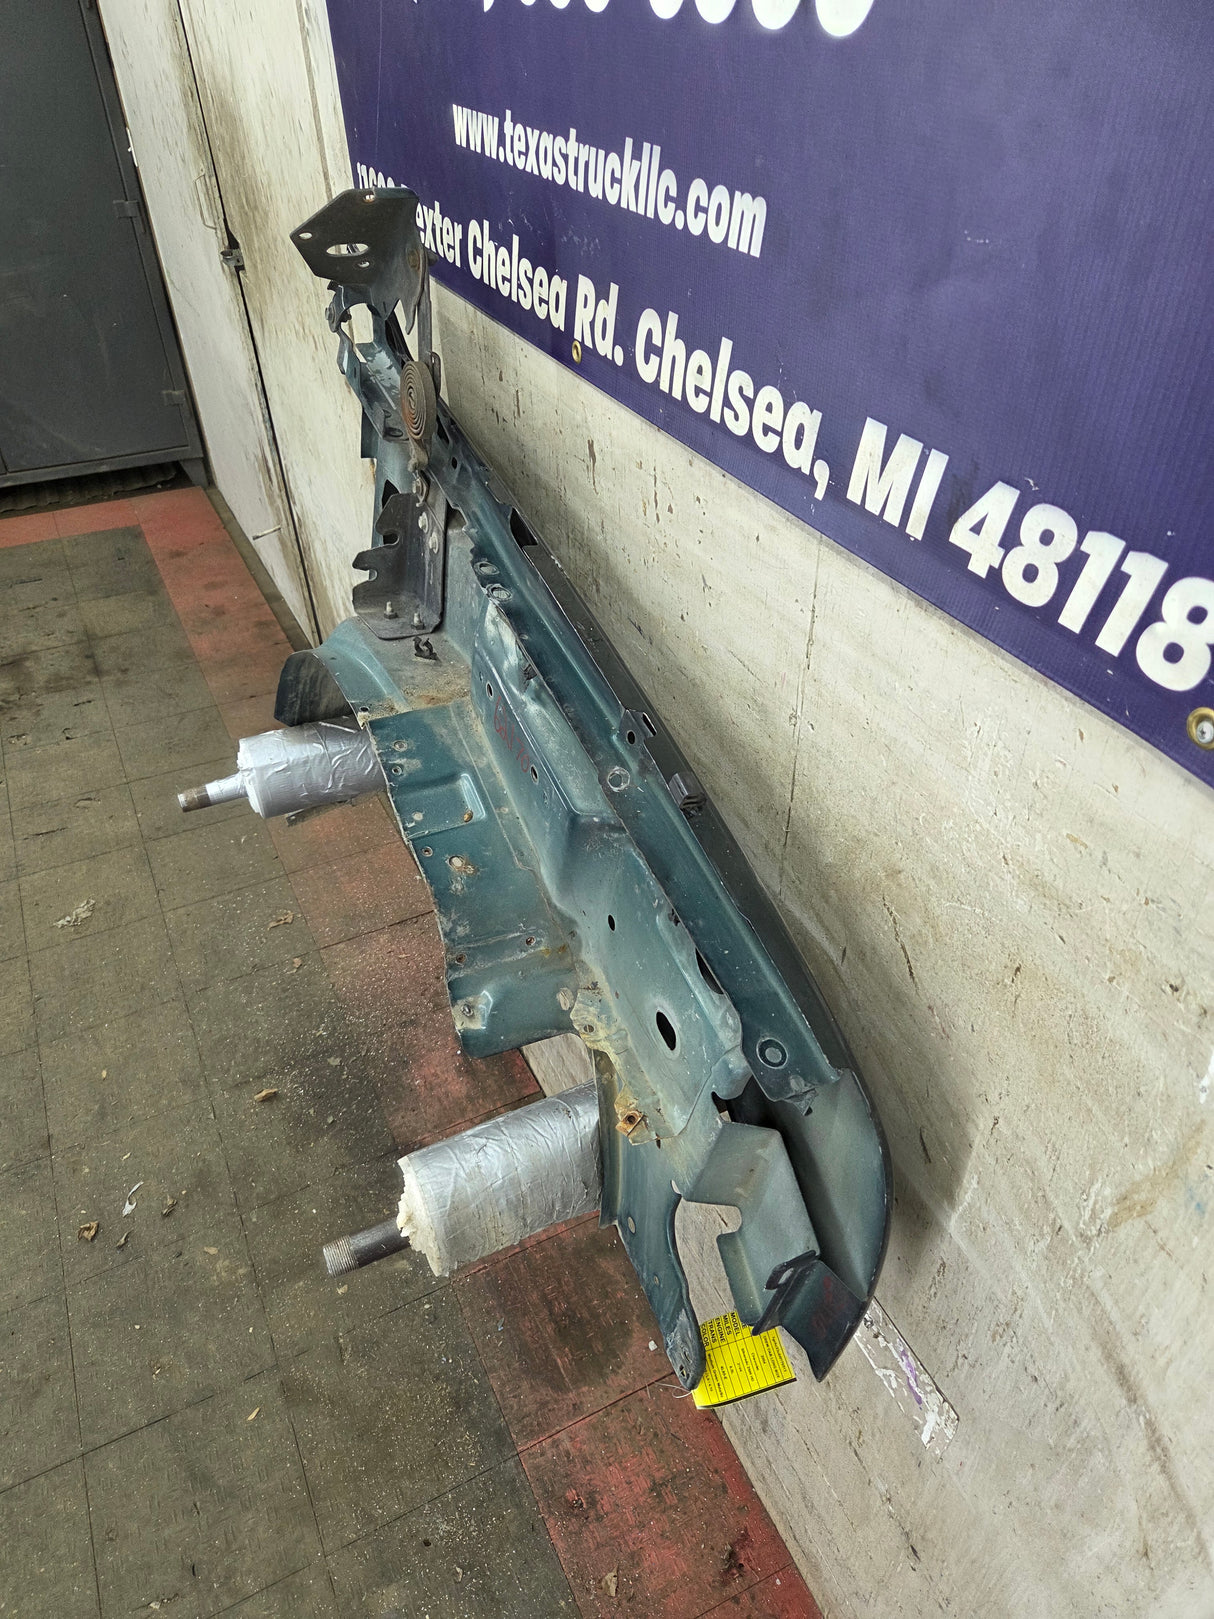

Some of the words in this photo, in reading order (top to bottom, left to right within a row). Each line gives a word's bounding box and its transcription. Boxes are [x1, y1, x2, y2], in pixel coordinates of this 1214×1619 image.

[452, 104, 767, 258] www.texastruckllc.com
[415, 200, 463, 268] exter
[467, 219, 568, 332] Chelsea
[573, 274, 624, 367] Rd.
[635, 308, 831, 502] Chelsea,
[846, 416, 950, 541] MI
[949, 481, 1214, 692] 48118
[700, 1323, 709, 1347] COLOR
[707, 1320, 717, 1343] TRANS
[714, 1317, 726, 1343] ENGINE
[722, 1314, 732, 1335] MILES
[729, 1311, 741, 1336] MODEL
